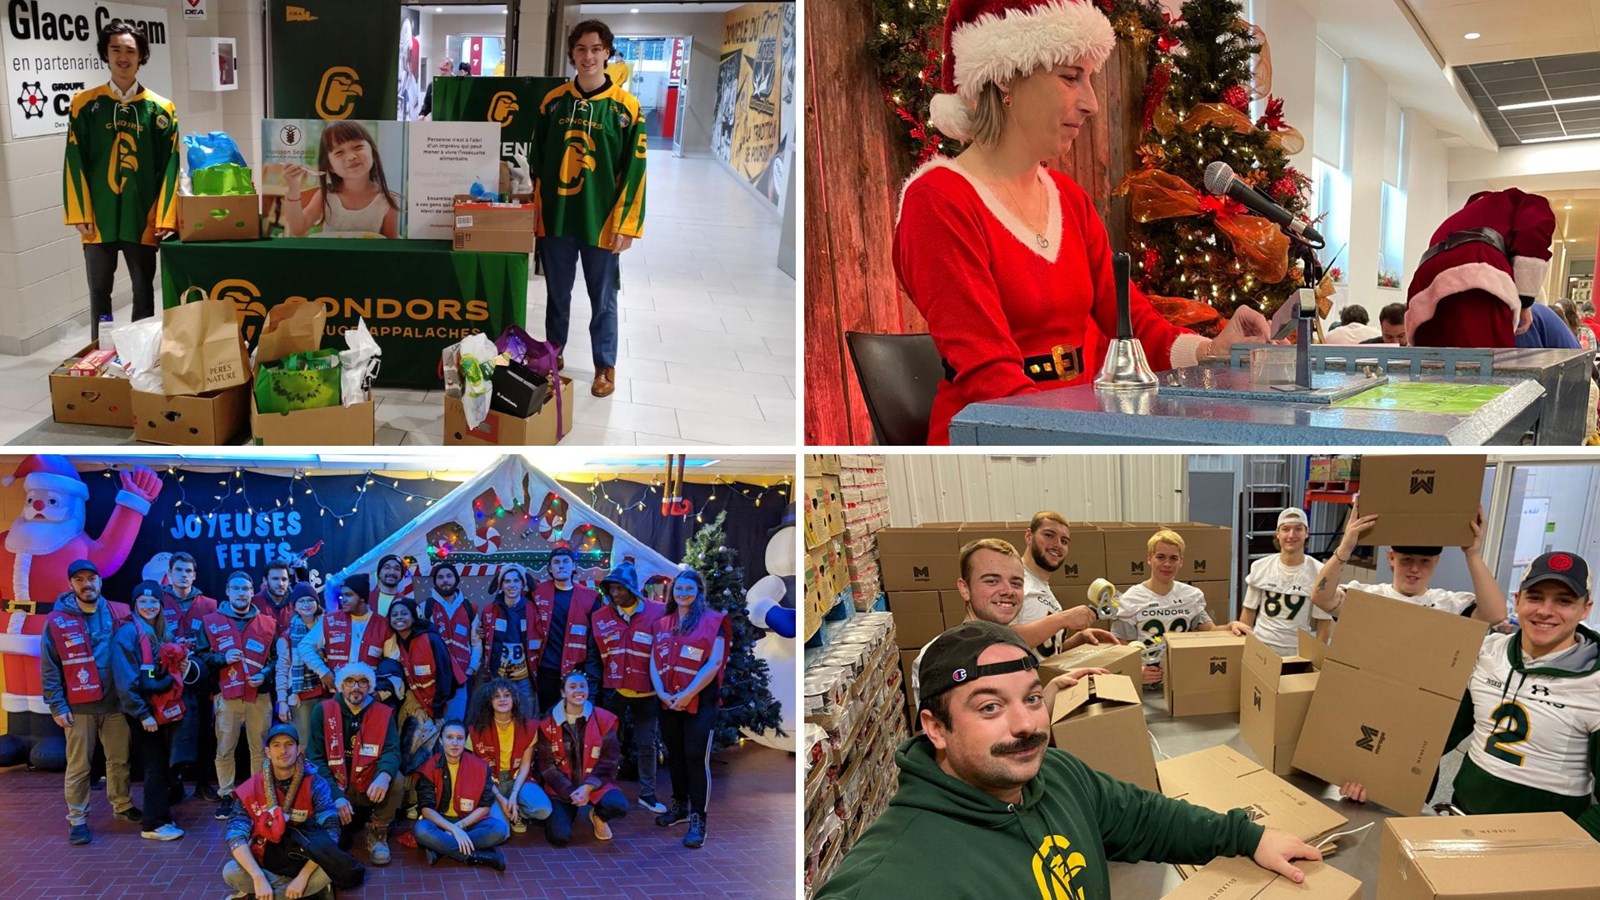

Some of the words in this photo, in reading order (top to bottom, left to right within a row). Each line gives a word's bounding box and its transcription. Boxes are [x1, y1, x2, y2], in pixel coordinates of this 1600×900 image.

[8, 0, 90, 41] Glace
[473, 43, 480, 51] 6
[13, 58, 24, 71] en
[35, 52, 105, 74] partenariat
[472, 58, 479, 66] 7
[51, 82, 85, 91] GROUPE
[558, 117, 603, 130] CONDORS
[284, 296, 489, 321] ONDORS
[369, 326, 481, 339] APPALACHES
[206, 371, 237, 384] NATURE
[170, 511, 302, 539] JOYEUSES
[215, 541, 293, 569] FETES
[1141, 609, 1191, 617] CONDORS
[1264, 590, 1307, 620] 89
[1484, 701, 1532, 767] 2
